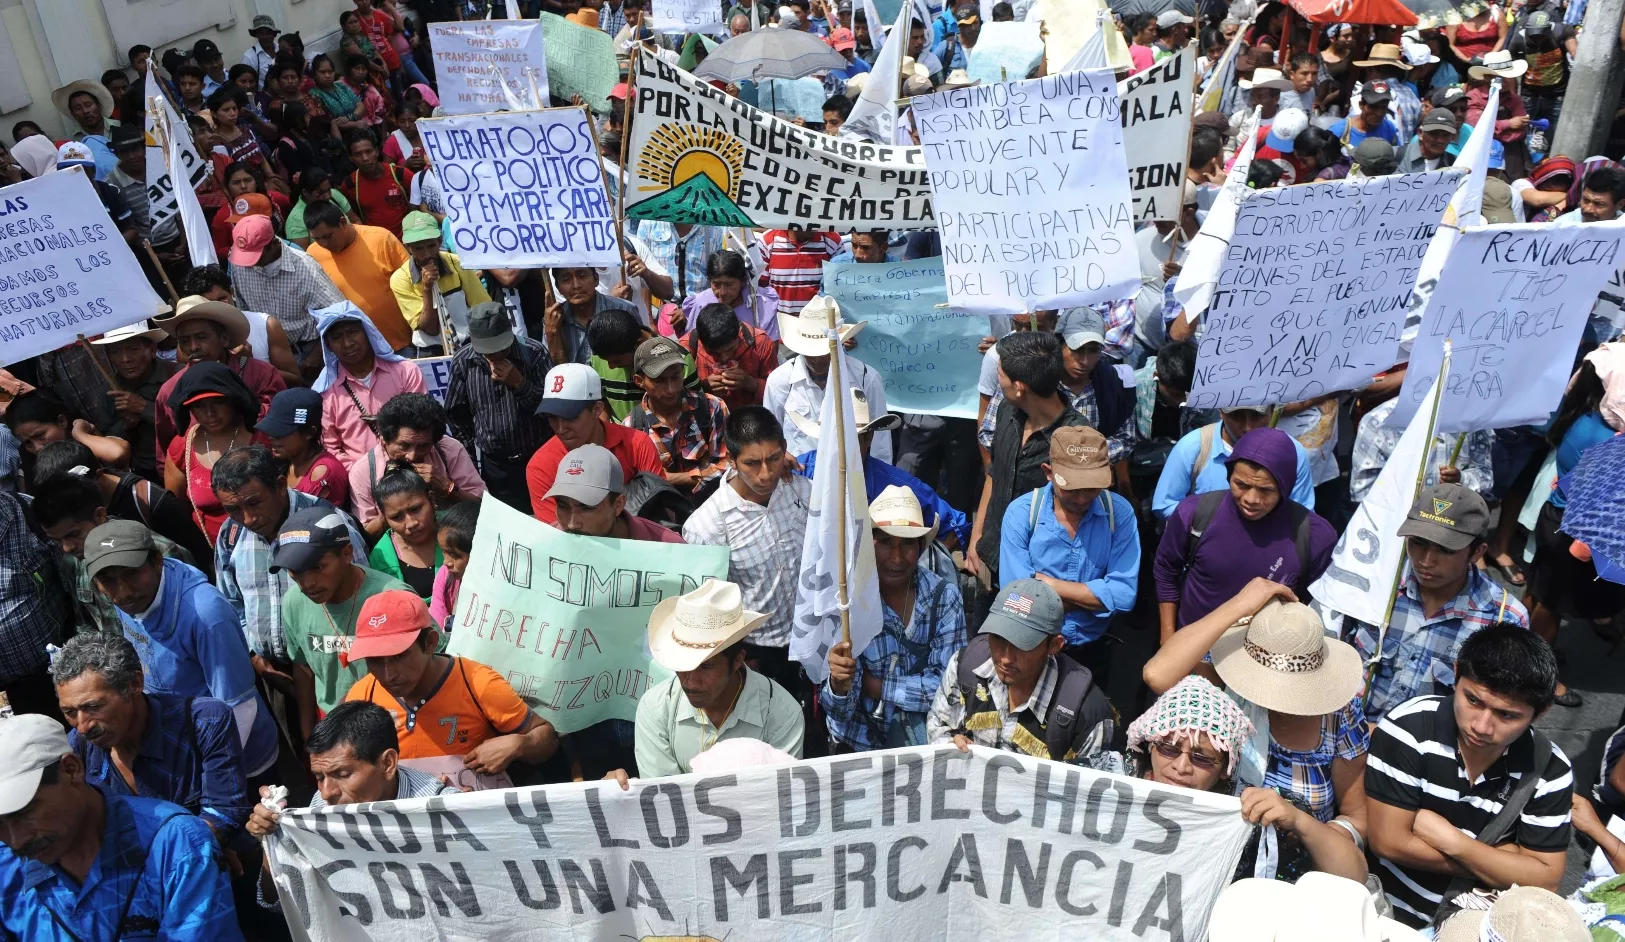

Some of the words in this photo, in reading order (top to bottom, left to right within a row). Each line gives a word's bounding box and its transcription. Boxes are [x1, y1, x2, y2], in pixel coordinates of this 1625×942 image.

[435, 26, 465, 36] FUERA
[474, 24, 495, 36] LAS
[466, 38, 519, 49] EMPRESAS
[435, 52, 529, 63] TRANSNACIONALES
[520, 67, 541, 78] LS
[911, 81, 1028, 113] EXIGIMOS
[1039, 70, 1093, 101] UNA
[637, 87, 692, 122] POR
[697, 102, 729, 133] LA
[920, 103, 1055, 136] ASAMBLEA
[1067, 94, 1120, 122] CONS
[742, 149, 863, 199] CODECA
[931, 166, 1047, 197] POPULAR
[1053, 162, 1070, 191] Y
[1434, 170, 1461, 186] LA
[736, 179, 894, 221] EXIGIMOS
[902, 198, 935, 221] LA
[1128, 161, 1182, 191] ION
[1380, 197, 1415, 216] EN
[1417, 192, 1452, 213] LAS
[75, 250, 112, 273] LOS
[1001, 231, 1122, 263] ESPALDAS
[1227, 236, 1345, 262] EMPRESAS
[1355, 231, 1369, 247] E
[1311, 259, 1347, 282] DEL
[1360, 242, 1430, 271] ESTADO
[1481, 230, 1622, 267] RENUNCIA
[833, 268, 883, 286] Fuera
[949, 272, 992, 296] DEL
[1289, 288, 1316, 306] EL
[1326, 270, 1389, 302] PUEBLO
[1396, 266, 1421, 286] TE
[0, 297, 113, 343] NATURALES
[1270, 309, 1328, 333] QUE
[1429, 304, 1466, 338] LA
[1468, 302, 1565, 344] CARCEL
[1262, 332, 1290, 356] Y
[1292, 330, 1332, 358] NO
[1450, 343, 1505, 372] TE
[1191, 360, 1241, 390] NES
[1248, 354, 1317, 381] MÁS
[1327, 352, 1357, 374] AL
[1411, 370, 1504, 403] EPERA
[1192, 380, 1325, 409] PUEBLO
[490, 533, 533, 590] NO
[545, 555, 666, 609] SOMOS
[460, 592, 602, 661] DERECHA
[506, 670, 543, 700] DE
[438, 715, 459, 745] 7
[504, 789, 556, 850] Y
[584, 774, 745, 851] LOS
[776, 748, 1195, 856] DERECHOS
[319, 858, 484, 926] SON
[503, 857, 675, 922] UNA
[709, 832, 1187, 942] MERCANCIA
